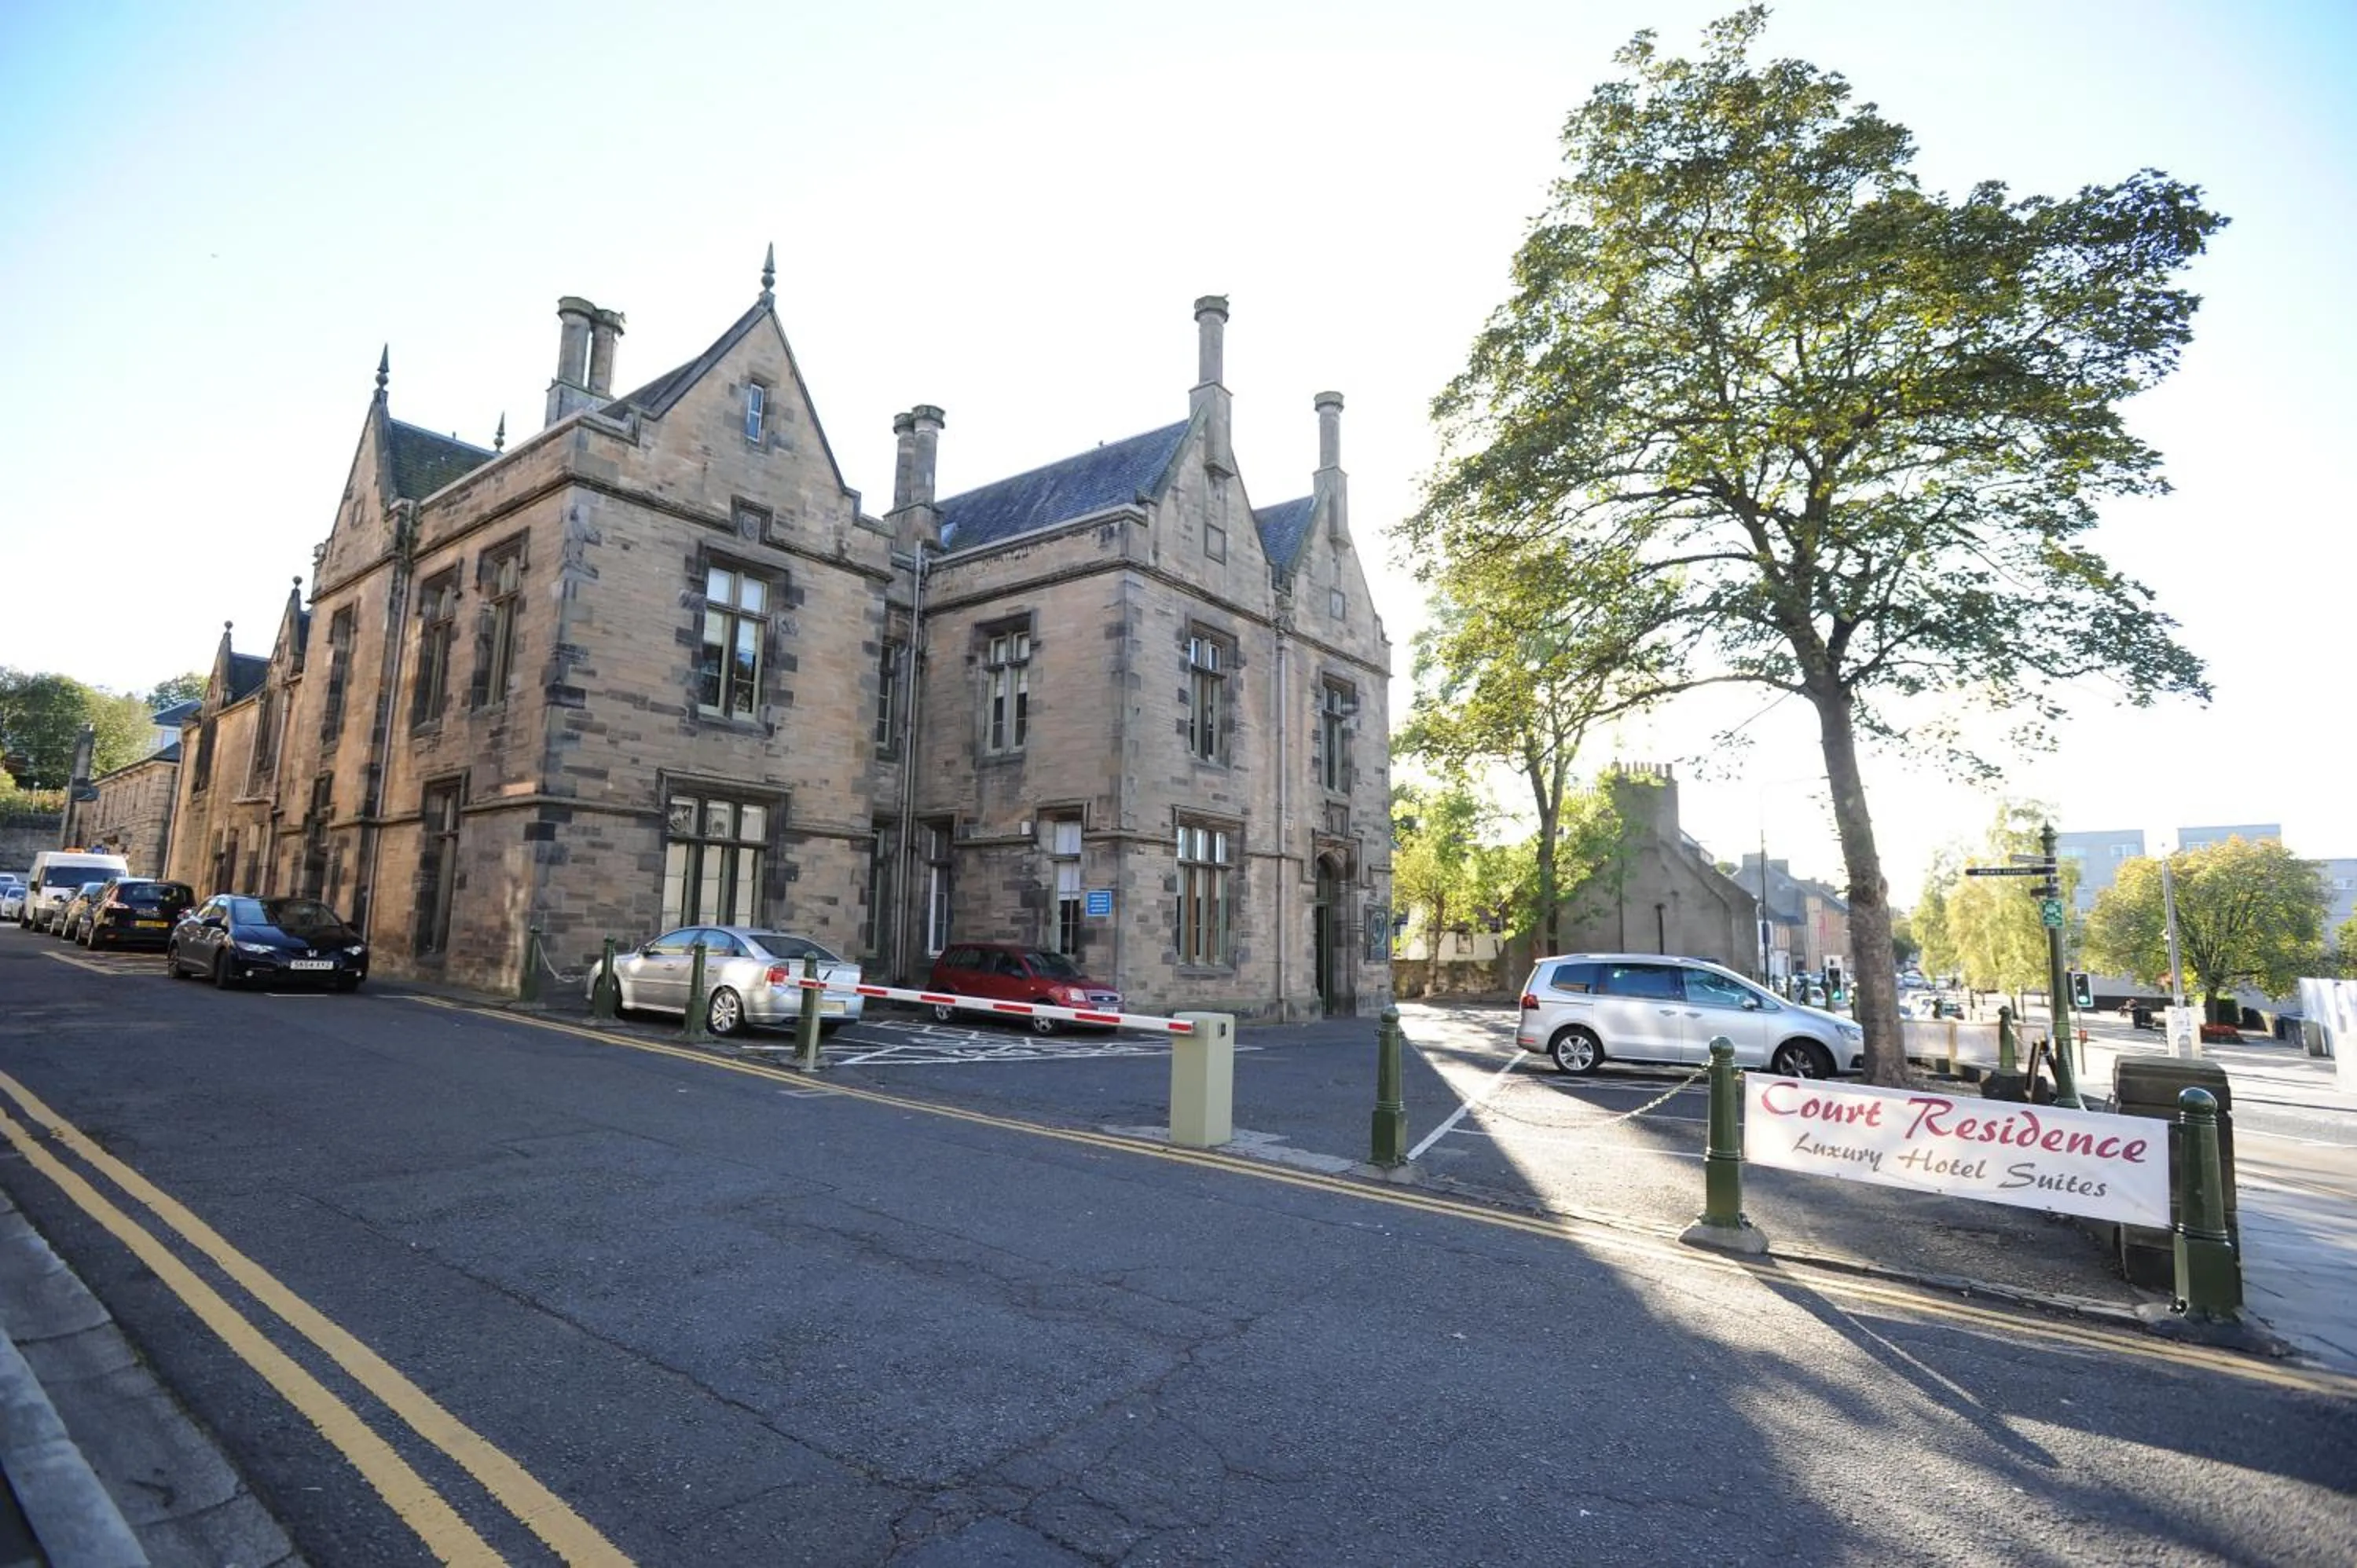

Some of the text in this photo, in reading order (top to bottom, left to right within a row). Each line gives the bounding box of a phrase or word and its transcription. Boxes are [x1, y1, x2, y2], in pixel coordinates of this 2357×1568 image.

[1761, 1082, 2147, 1163] Court Residence
[1792, 1132, 2106, 1198] Luxury Hotel Suites
